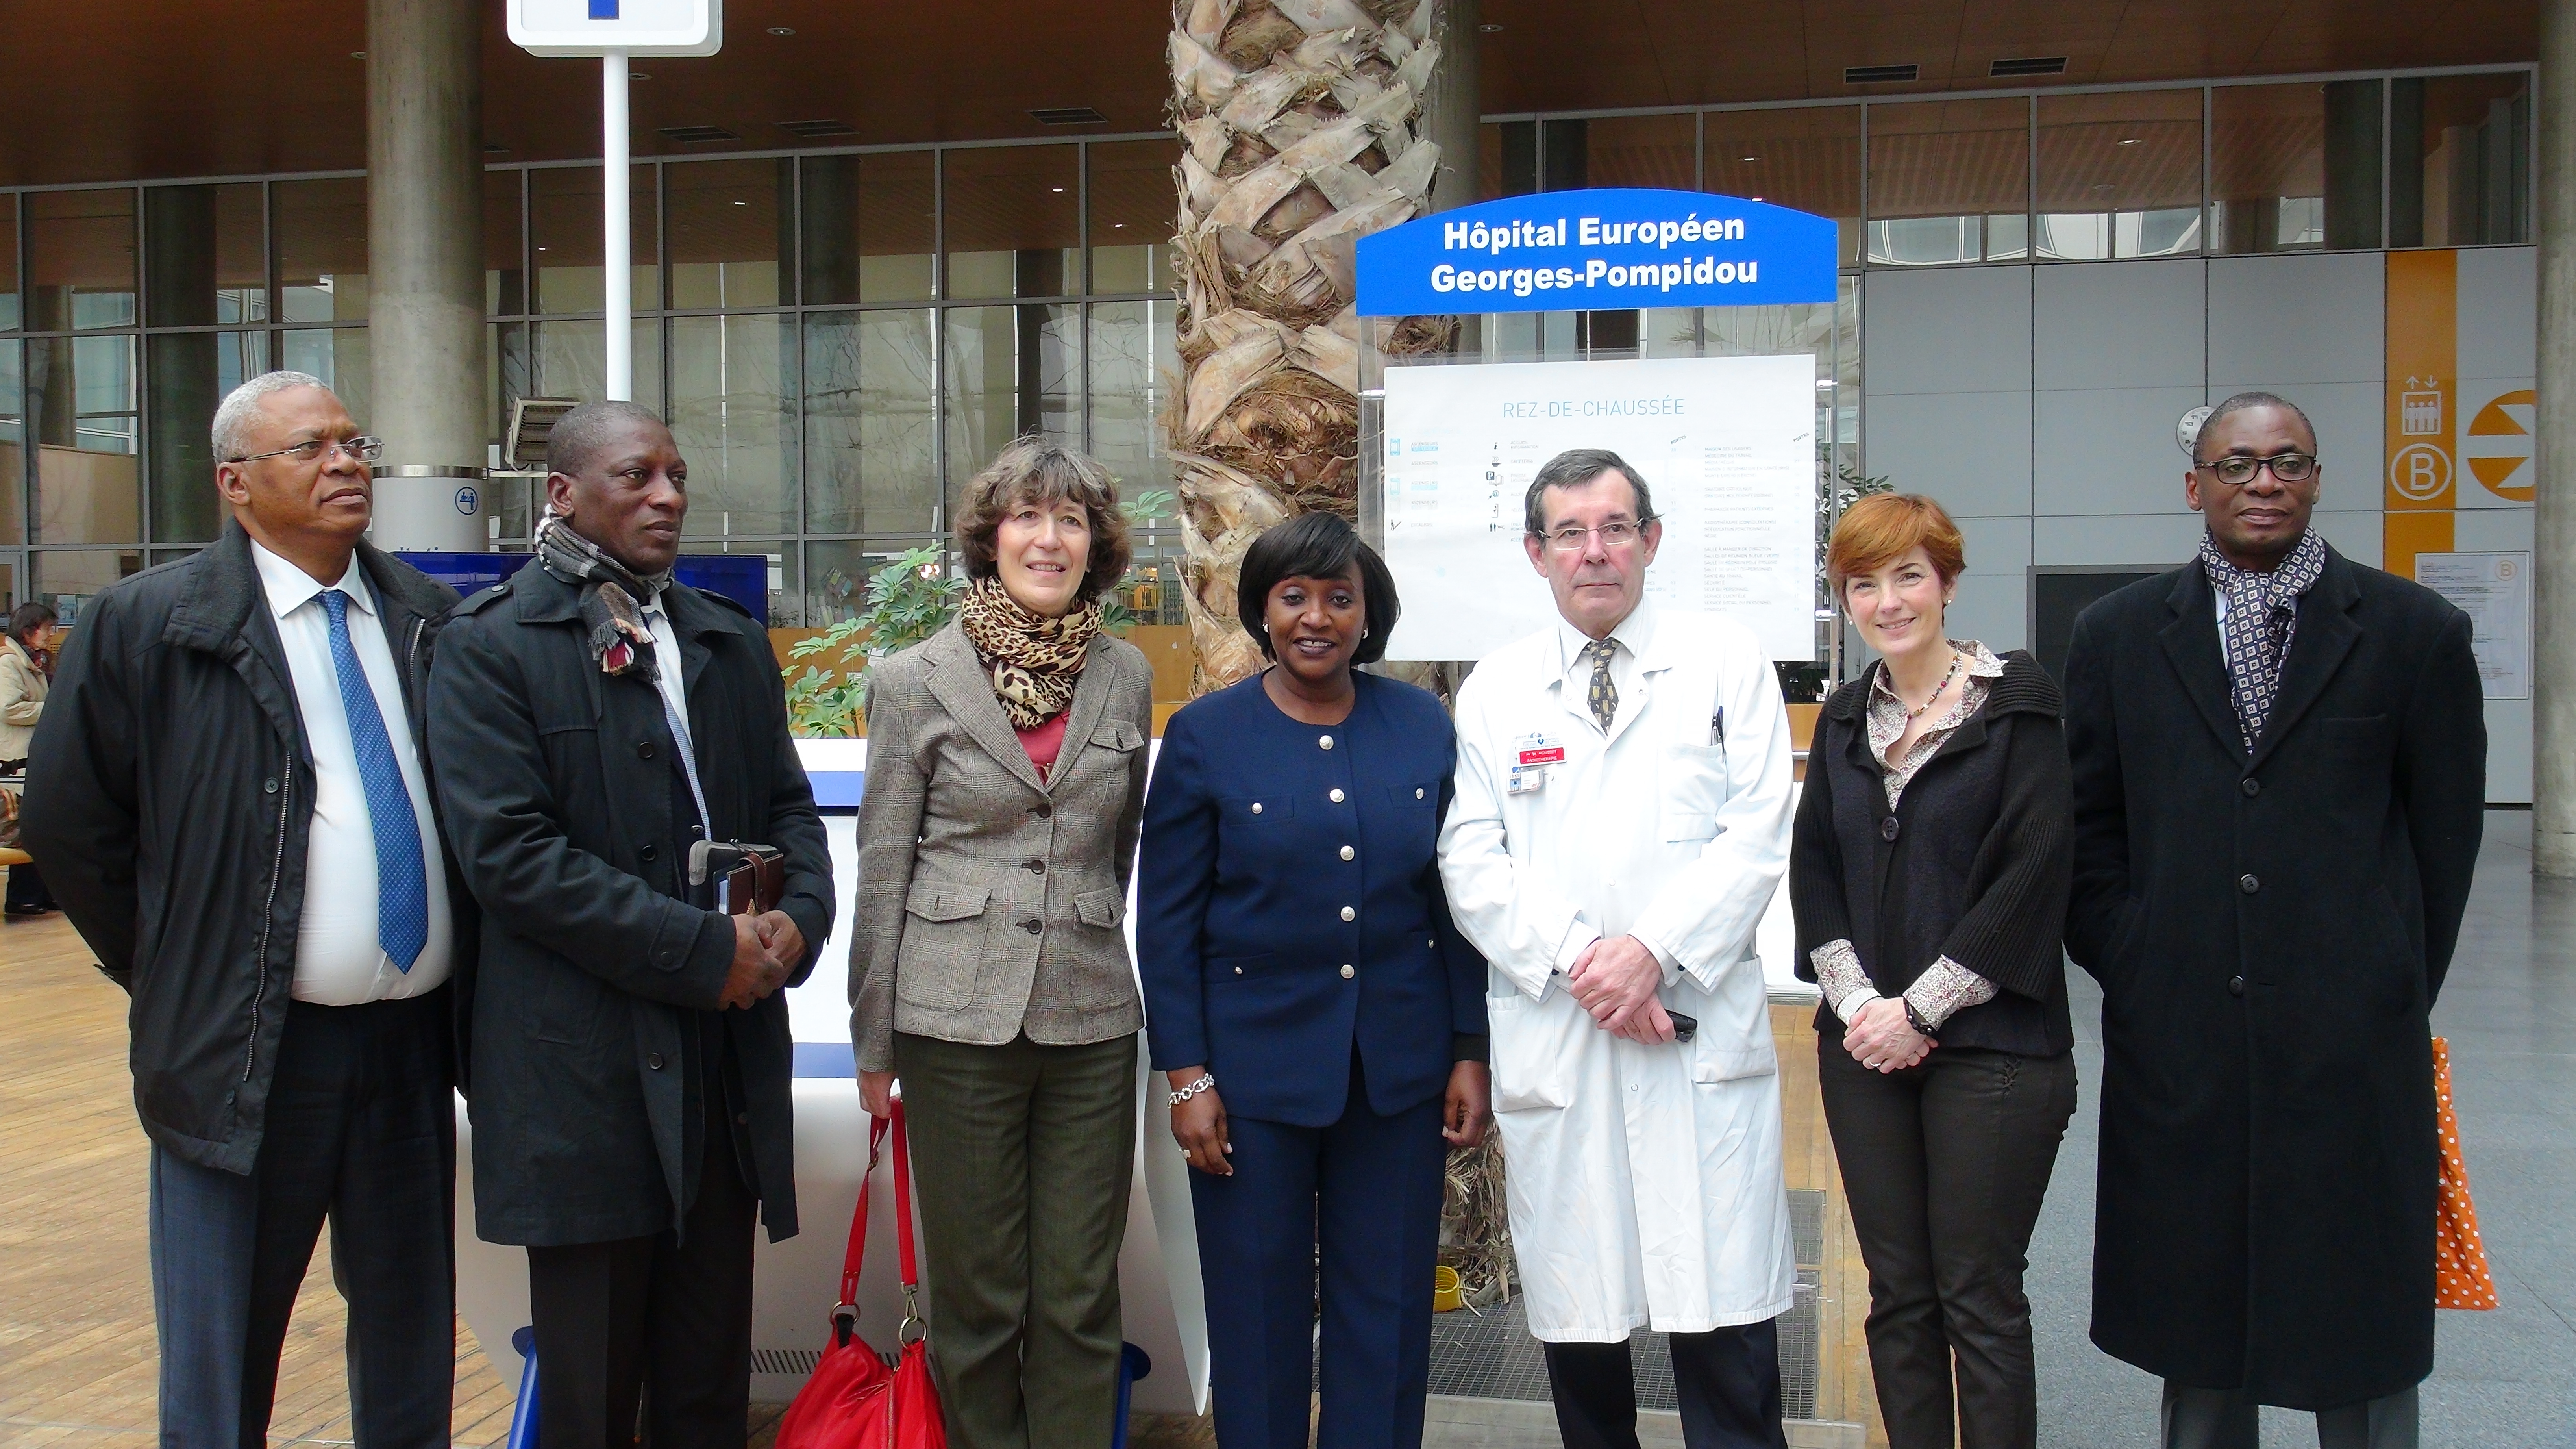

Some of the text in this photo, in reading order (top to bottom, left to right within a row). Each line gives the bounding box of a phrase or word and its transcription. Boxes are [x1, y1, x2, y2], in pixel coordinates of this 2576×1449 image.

[1445, 213, 1744, 255] Hôpital Européen
[1431, 256, 1758, 296] Georges-Pompidou
[1503, 395, 1685, 418] REZ-DE-CHAUSSÉE
[2411, 453, 2436, 490] B
